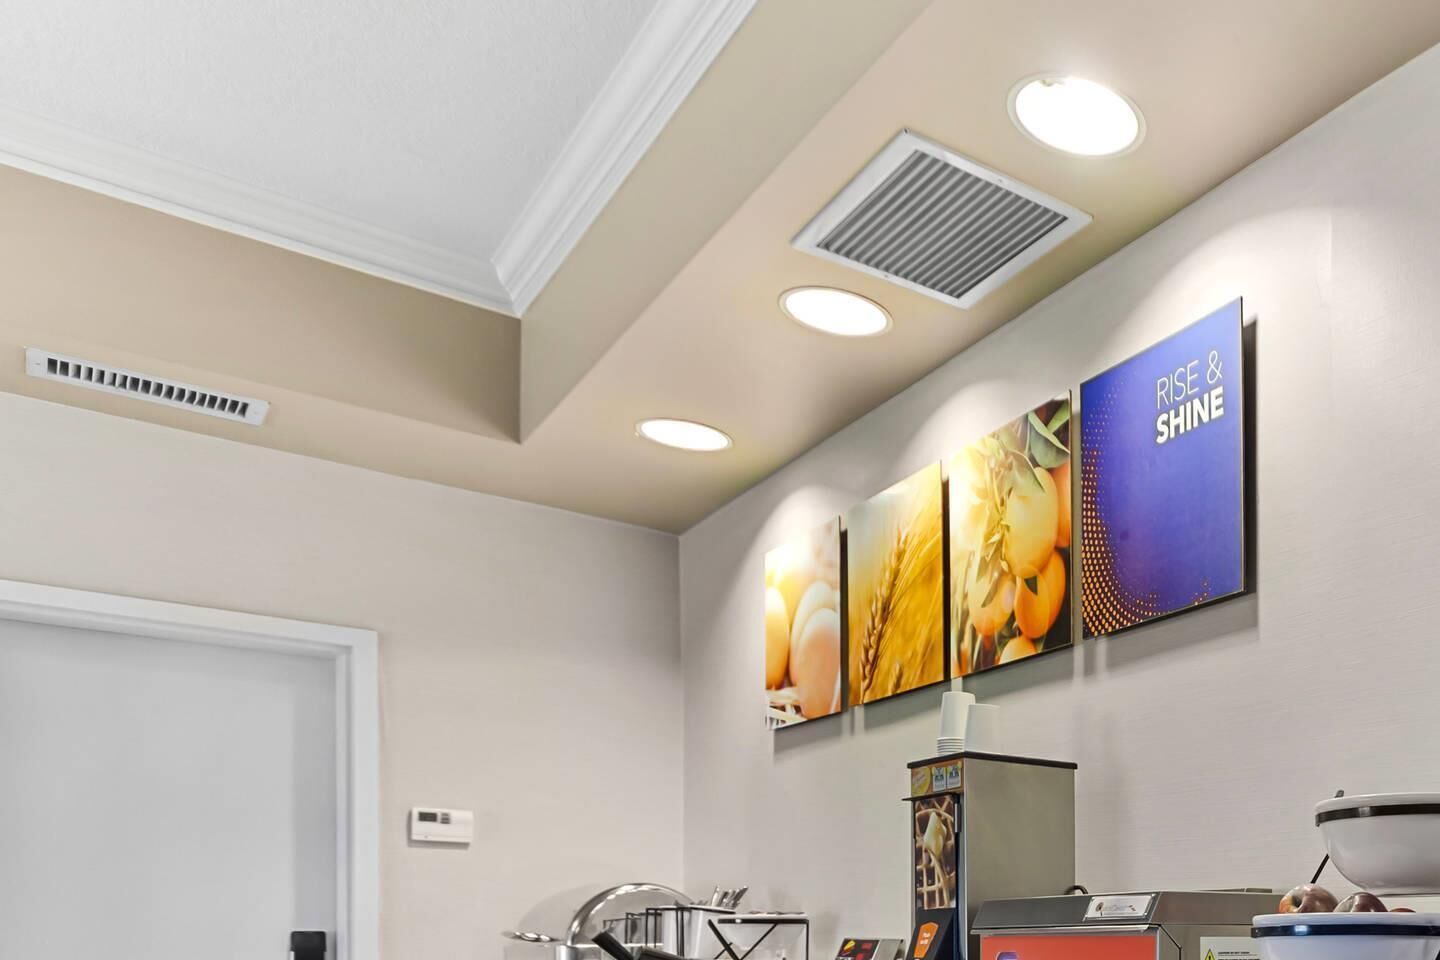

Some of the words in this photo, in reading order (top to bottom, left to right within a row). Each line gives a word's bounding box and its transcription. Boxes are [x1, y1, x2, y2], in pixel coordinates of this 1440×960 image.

[1157, 360, 1198, 408] RISE
[1207, 350, 1223, 384] &
[1156, 387, 1224, 444] SHINE
